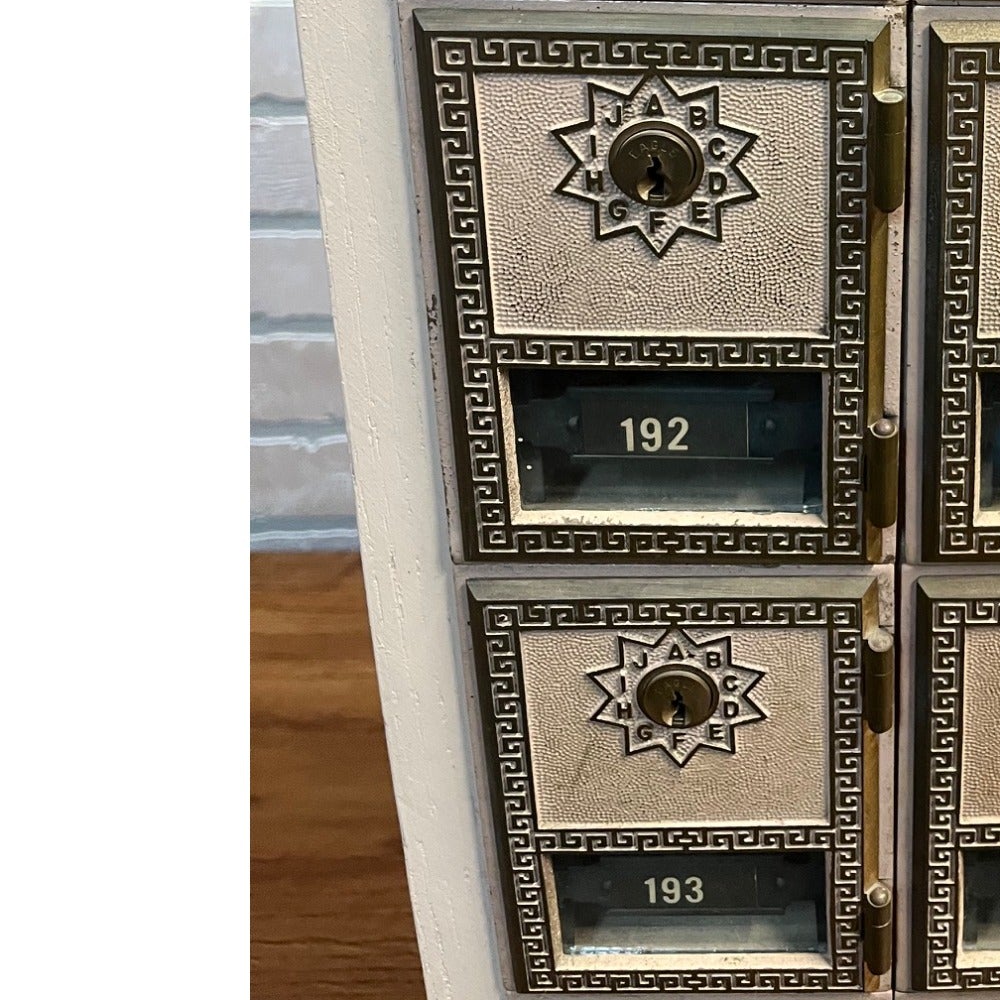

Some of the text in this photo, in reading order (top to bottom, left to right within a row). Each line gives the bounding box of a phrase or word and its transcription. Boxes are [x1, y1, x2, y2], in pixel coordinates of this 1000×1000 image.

[604, 102, 623, 127] J
[645, 93, 665, 117] A
[689, 105, 707, 130] B
[708, 137, 726, 161] C
[584, 170, 604, 193] H
[708, 171, 728, 195] D
[608, 199, 629, 221] G
[691, 200, 710, 224] E
[649, 210, 668, 234] F
[621, 418, 688, 451] 192
[632, 650, 648, 669] J
[667, 643, 685, 661] A
[705, 651, 722, 669] B
[722, 675, 739, 692] C
[616, 700, 633, 720] H
[723, 701, 740, 719] D
[636, 723, 653, 741] G
[672, 732, 688, 750] F
[708, 723, 724, 741] E
[645, 877, 703, 903] 193
